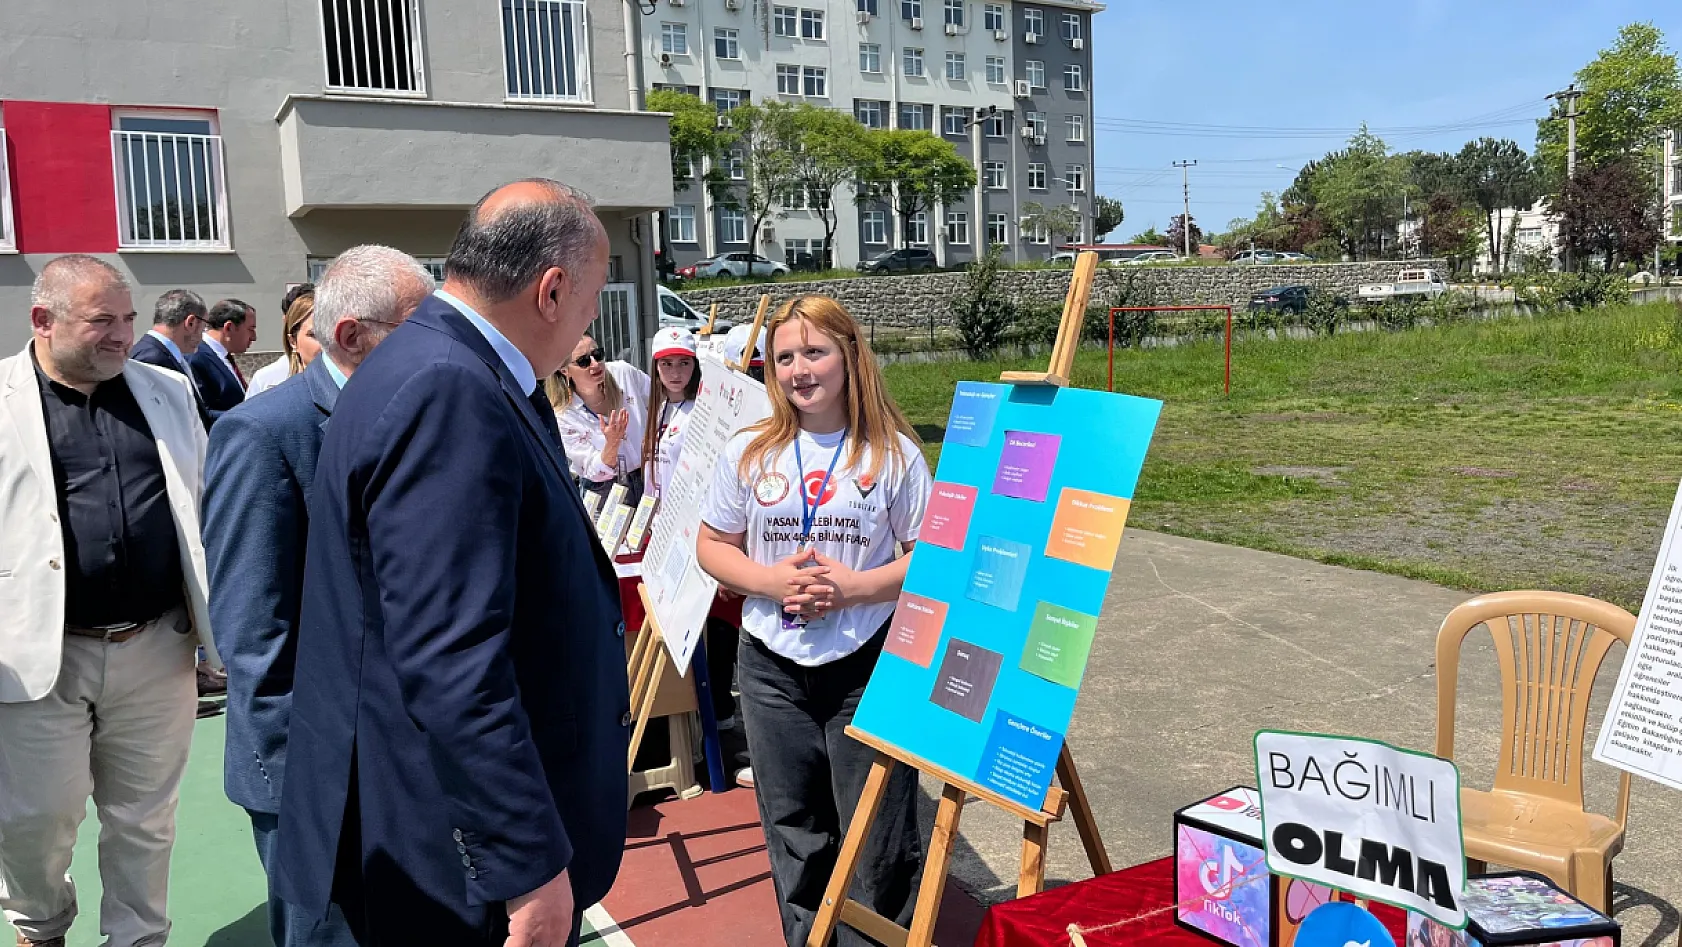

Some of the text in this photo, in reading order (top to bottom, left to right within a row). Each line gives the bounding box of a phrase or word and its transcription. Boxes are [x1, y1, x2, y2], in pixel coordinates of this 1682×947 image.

[1627, 690, 1660, 705] hakkında
[1648, 718, 1656, 726] ve
[1269, 750, 1436, 823] BAĞIMLI
[1272, 822, 1458, 912] OLMA
[1203, 899, 1241, 926] TikTok
